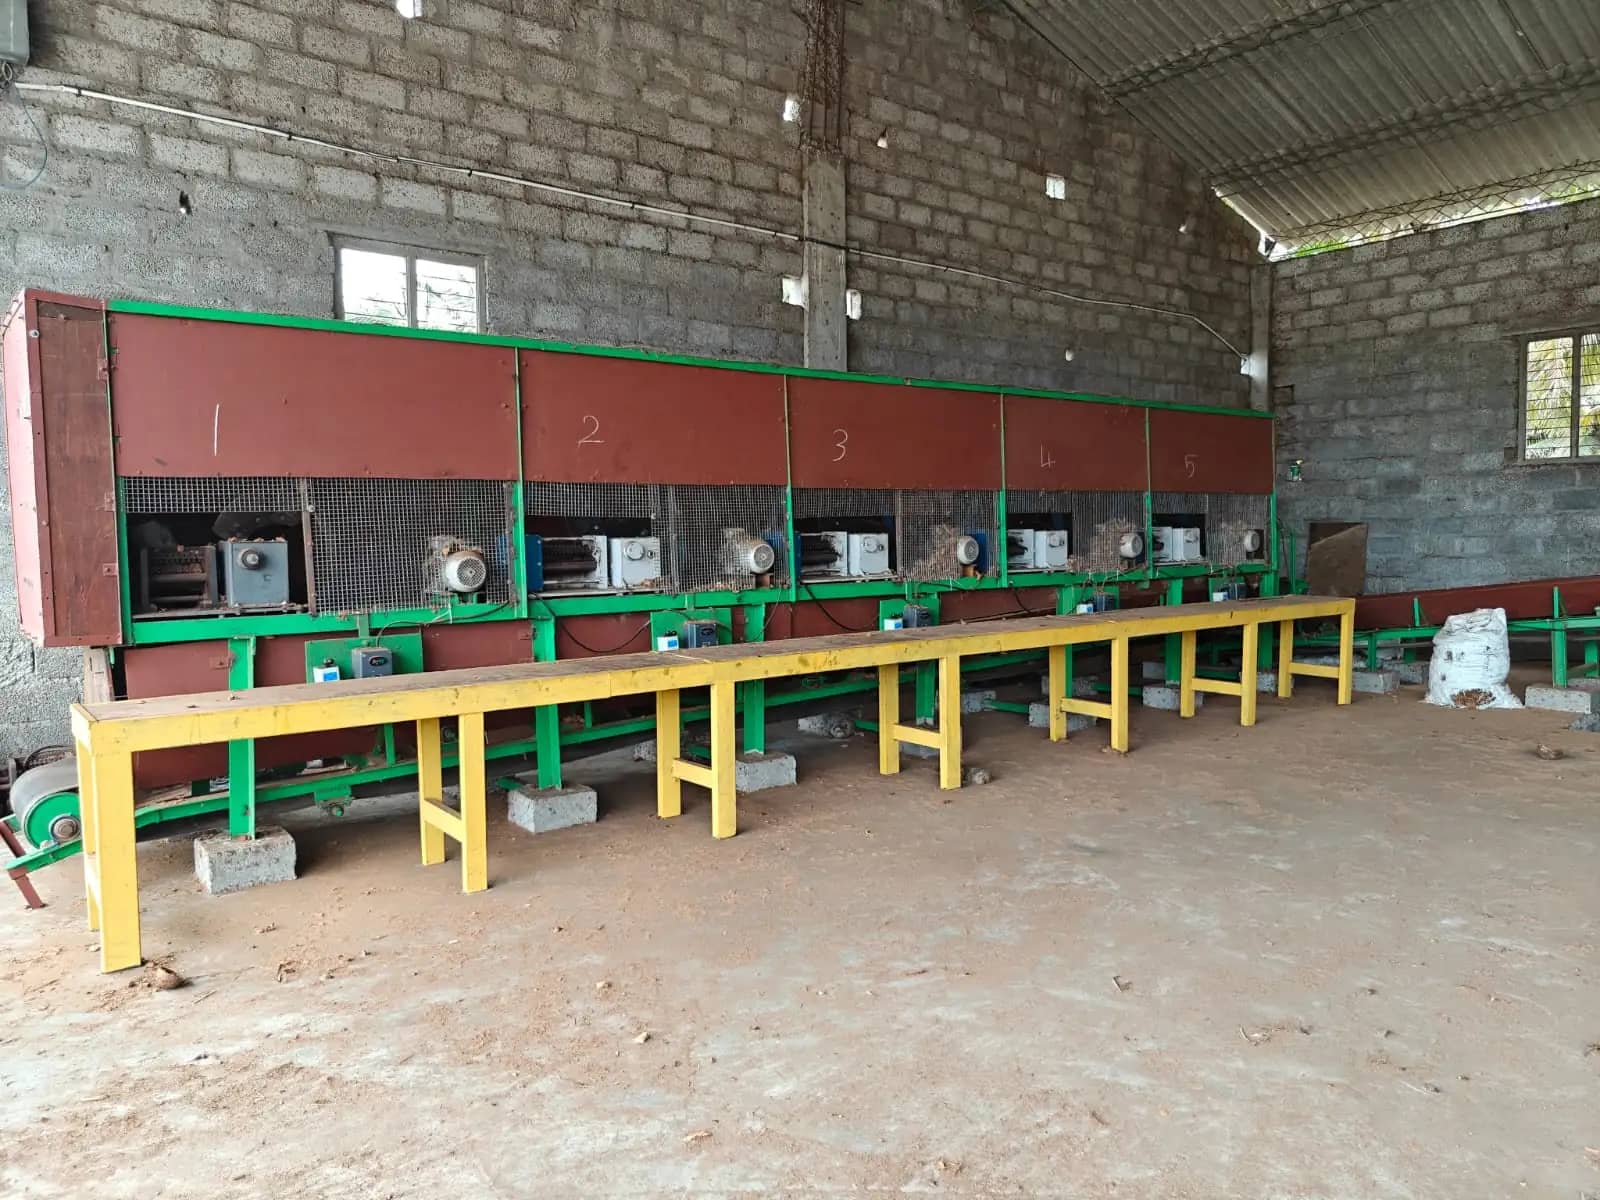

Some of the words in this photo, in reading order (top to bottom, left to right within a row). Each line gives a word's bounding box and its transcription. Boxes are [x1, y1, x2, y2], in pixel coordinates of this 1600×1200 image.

[577, 415, 606, 448] 2
[832, 428, 848, 462] 3
[1040, 442, 1056, 469] 4
[1184, 454, 1199, 479] 5
